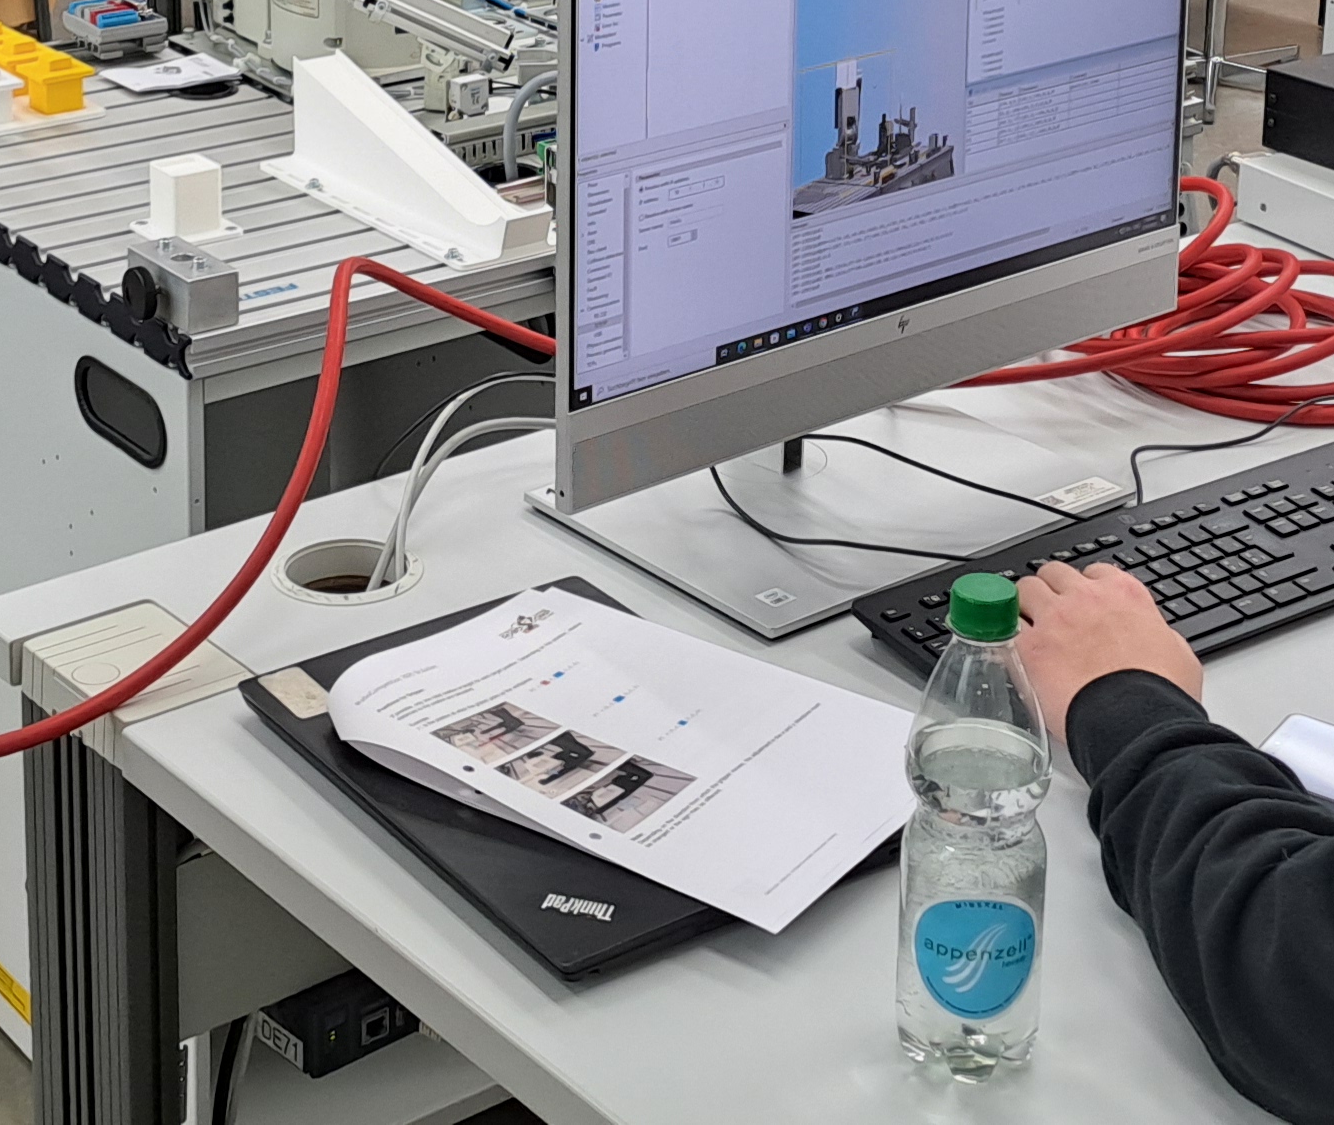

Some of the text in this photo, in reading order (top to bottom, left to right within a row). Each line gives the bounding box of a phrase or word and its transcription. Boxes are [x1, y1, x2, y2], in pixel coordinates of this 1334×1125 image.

[239, 282, 299, 302] FEST
[540, 892, 617, 923] ThinkPad
[923, 937, 1028, 962] appenzell
[261, 1019, 299, 1062] DE71
